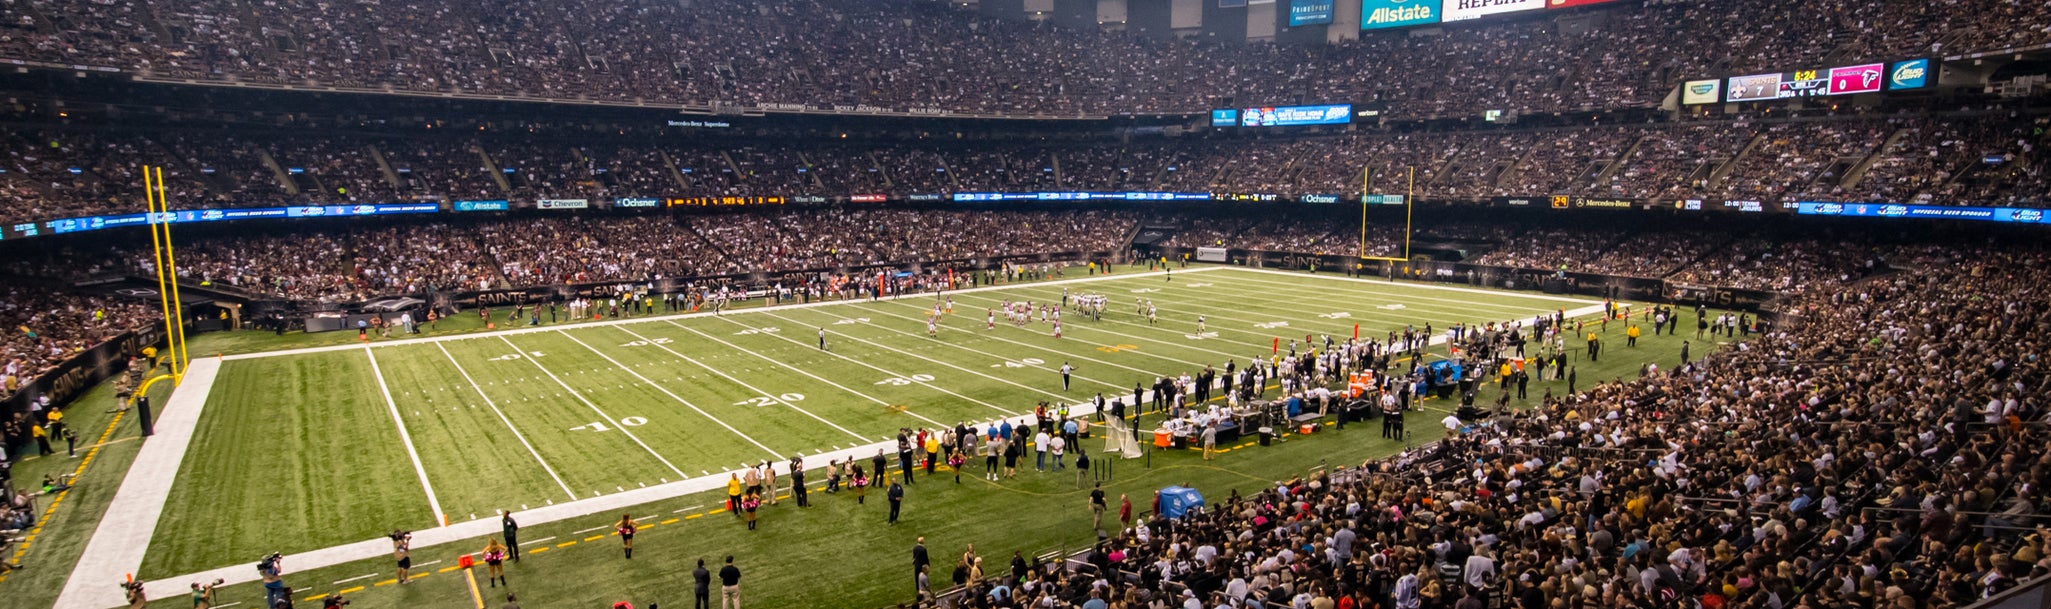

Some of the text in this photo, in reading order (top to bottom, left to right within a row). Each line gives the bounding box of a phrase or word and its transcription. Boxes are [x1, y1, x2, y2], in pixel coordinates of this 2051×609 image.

[1458, 0, 1525, 10] REPLA
[1367, 4, 1431, 24] Allstate
[1794, 71, 1816, 81] 5:24
[1839, 79, 1846, 90] 0
[1756, 86, 1765, 97] 7
[554, 199, 583, 207] Chevron
[622, 198, 656, 207] Ochsner
[1306, 194, 1336, 203] Ochsner
[1554, 197, 1567, 207] 29
[1586, 199, 1631, 207] Mercedes-Benz
[473, 202, 501, 210] Allstate
[2020, 209, 2042, 217] BUD
[478, 292, 526, 303] SAINTS
[885, 374, 936, 386] 30
[747, 393, 805, 407] 20
[586, 416, 658, 432] 10
